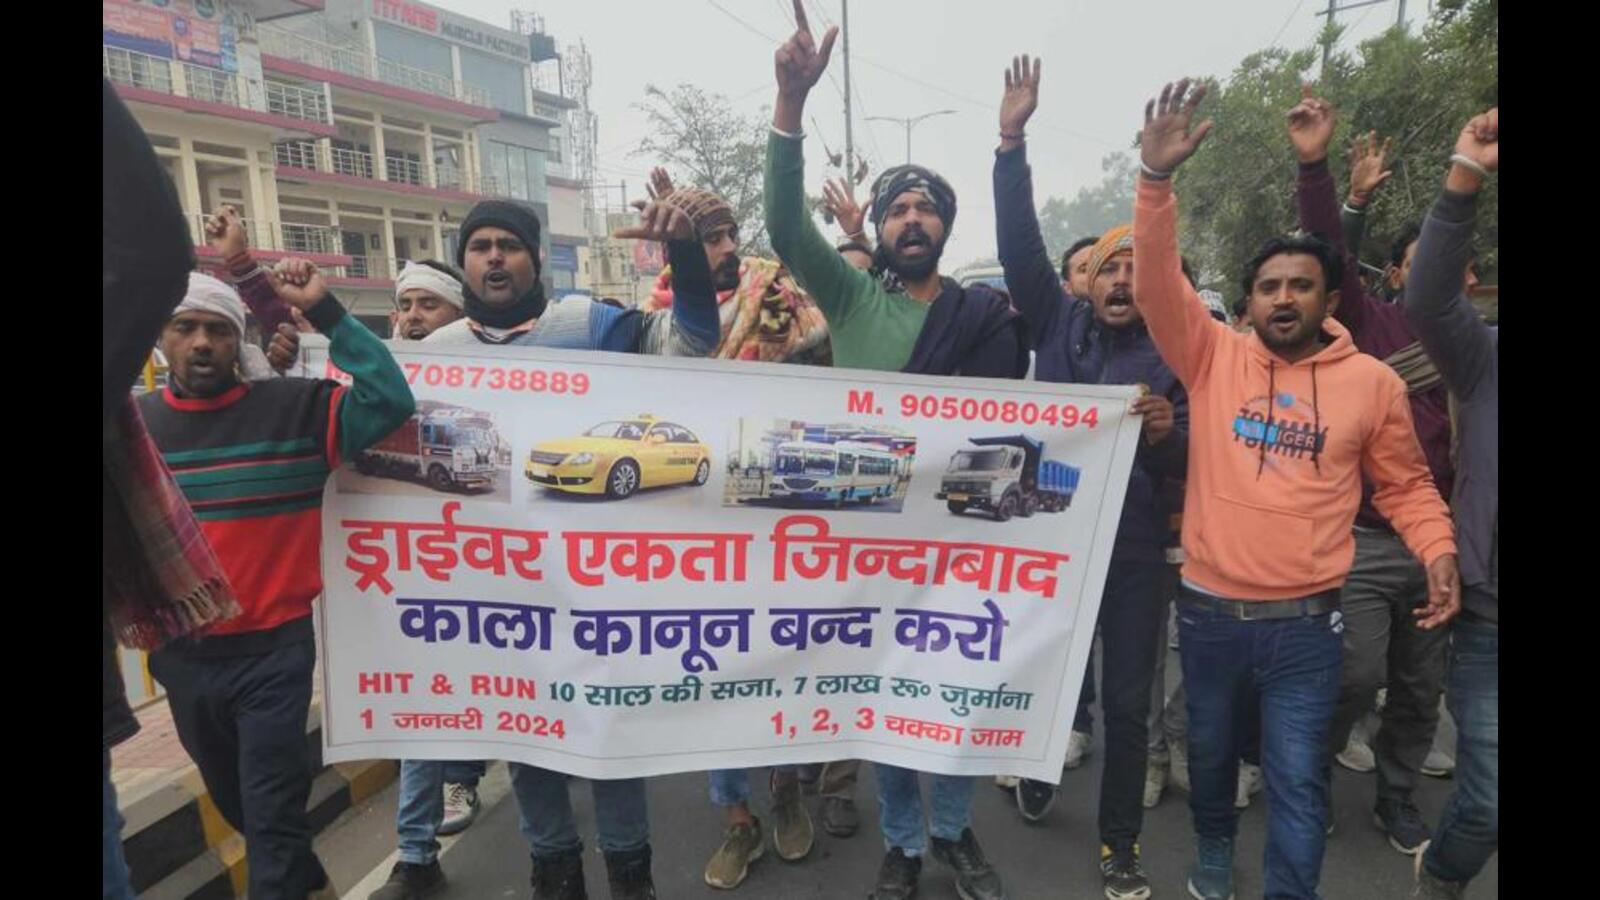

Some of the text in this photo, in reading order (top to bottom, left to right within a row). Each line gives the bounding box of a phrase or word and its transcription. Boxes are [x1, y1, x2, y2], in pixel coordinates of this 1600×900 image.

[404, 362, 591, 396] 708738889
[847, 389, 1099, 429] M. 9050080494
[340, 501, 1071, 599] ड्राईवर एकता जिन्दाबाद
[396, 598, 1010, 673] काला कानून बन्द करो
[358, 672, 414, 695] HIT
[431, 673, 453, 696] &
[471, 673, 537, 700] RUN
[549, 682, 575, 702] 10
[584, 684, 655, 707] साल
[661, 674, 702, 703] की
[710, 677, 783, 701] सजा,
[794, 677, 808, 695] 7
[815, 674, 883, 695] लाख
[940, 682, 1034, 717] जुर्माना
[360, 708, 566, 739] 1 जनवरी 2024
[771, 707, 1025, 748] 1, 2, 3 चक्का जाम
